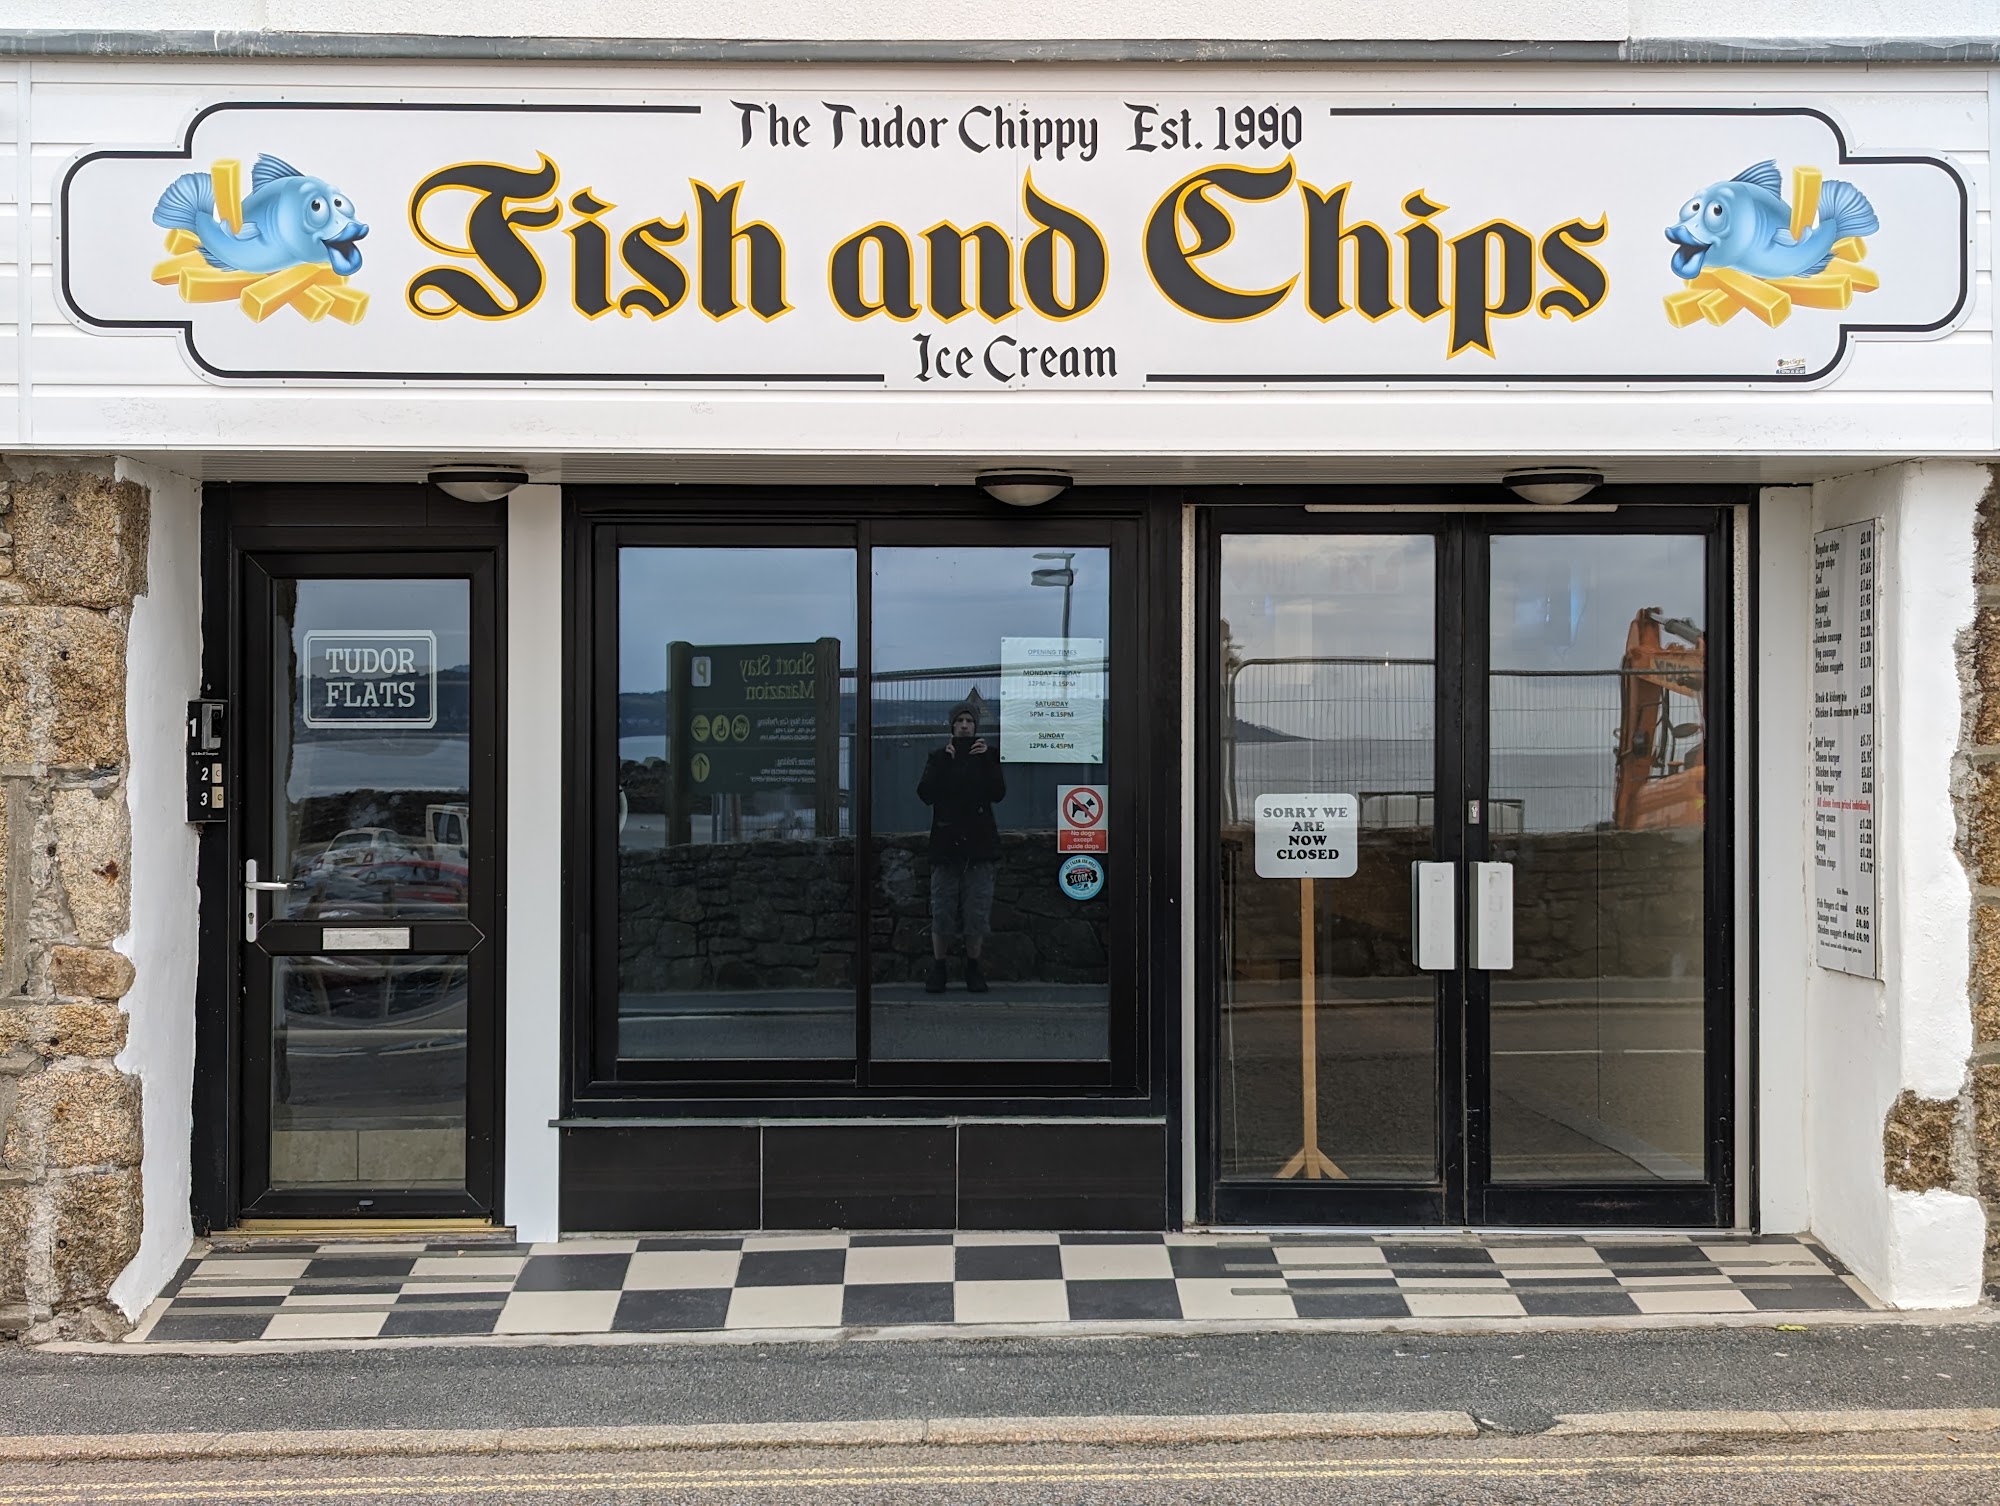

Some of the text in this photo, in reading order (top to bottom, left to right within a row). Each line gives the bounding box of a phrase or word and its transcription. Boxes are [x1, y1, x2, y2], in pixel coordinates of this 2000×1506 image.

[729, 99, 1302, 162] The Tudor Chippy Est. 1990
[408, 149, 1609, 361] Fish and Chips
[912, 332, 1118, 383] Ice Cream
[325, 648, 416, 674] TUDOR
[325, 681, 416, 708] FLATS
[189, 717, 197, 737] 1
[201, 767, 208, 782] 2
[200, 792, 208, 806] 3
[1262, 807, 1348, 818] SORRY WE
[1291, 821, 1325, 832] ARE
[1288, 835, 1328, 846] NOW
[1276, 849, 1339, 860] CLOSED
